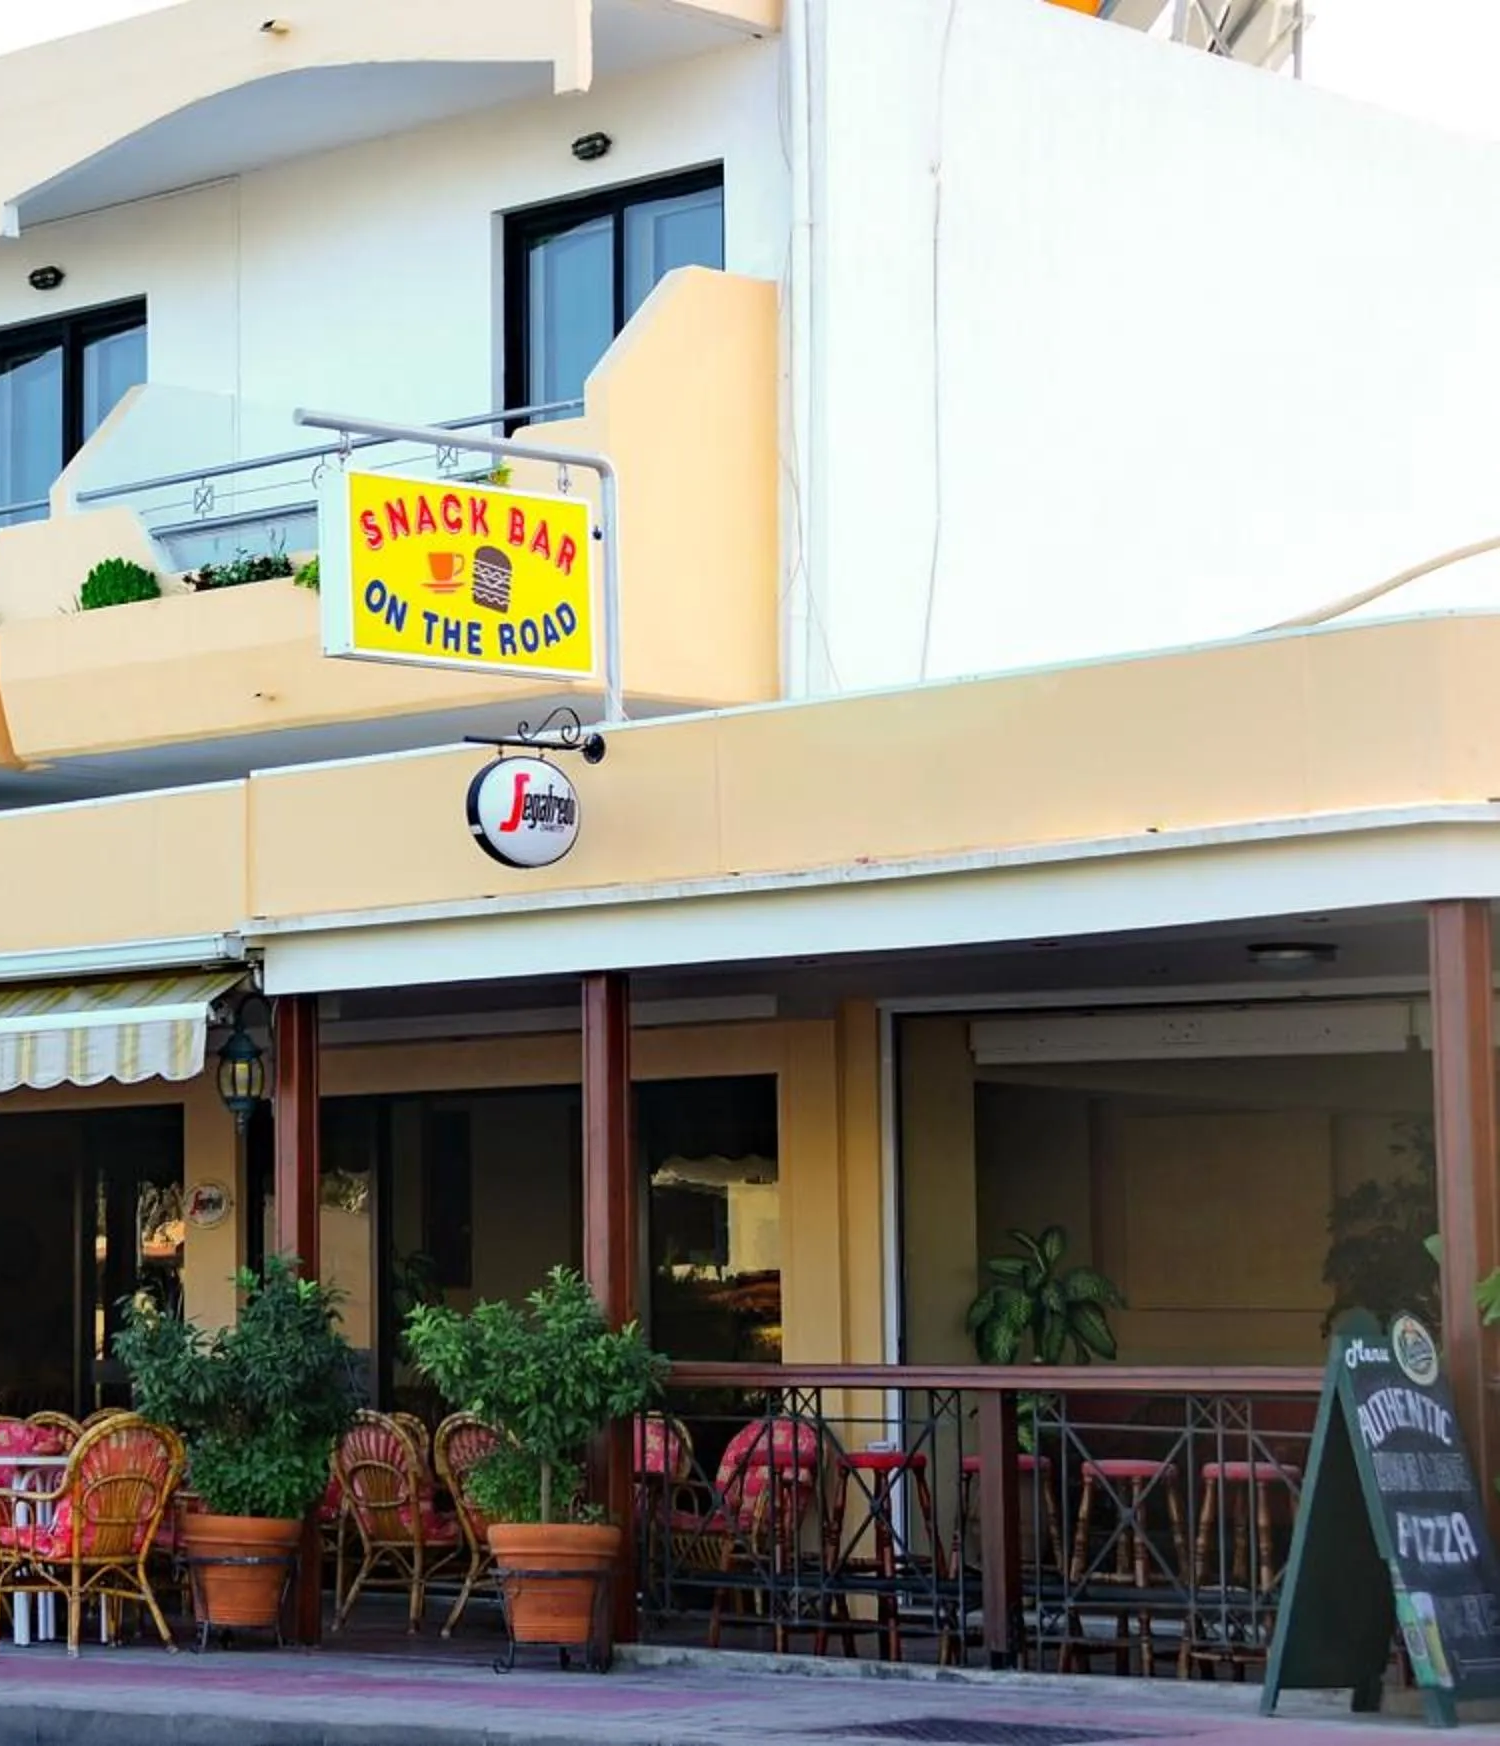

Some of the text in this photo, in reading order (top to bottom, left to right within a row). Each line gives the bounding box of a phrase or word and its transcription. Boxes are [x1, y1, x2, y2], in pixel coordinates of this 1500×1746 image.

[360, 494, 577, 575] SNACK BAR
[365, 579, 577, 656] ON THE ROAD
[1357, 1387, 1453, 1450] AUTHENTIC
[1395, 1511, 1479, 1565] PIZZA
